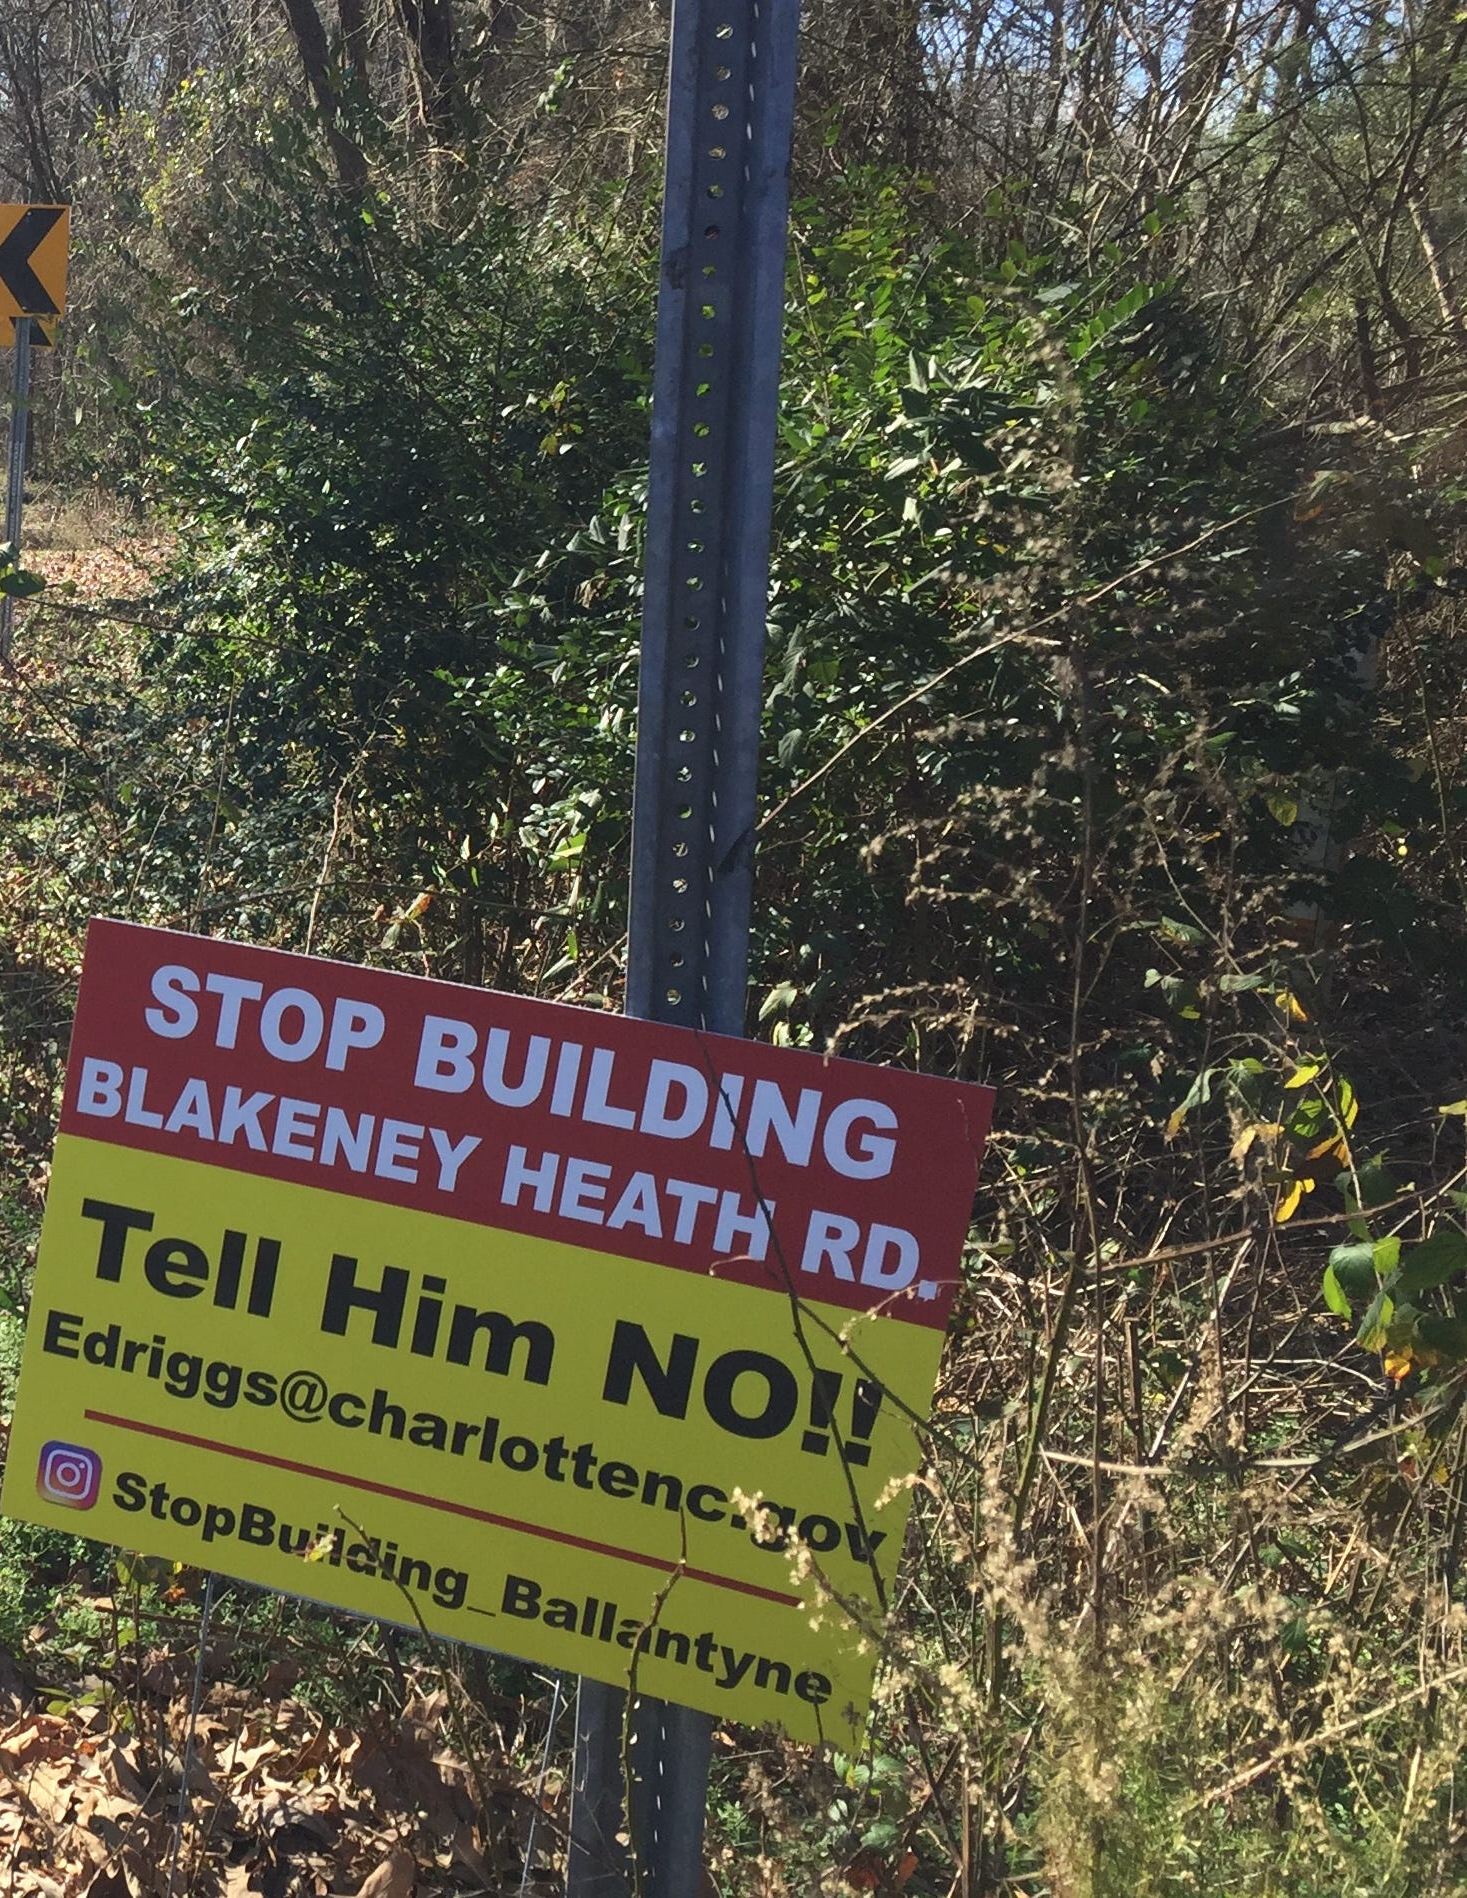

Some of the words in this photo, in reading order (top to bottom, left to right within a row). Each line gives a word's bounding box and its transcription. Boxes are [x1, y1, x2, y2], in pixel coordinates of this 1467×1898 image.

[75, 1056, 482, 1193] BLAKENEY
[500, 1145, 776, 1262] HEATH
[800, 1210, 940, 1301] RD.
[144, 964, 386, 1072] STOP
[413, 1014, 899, 1181] BUILDING
[42, 1309, 888, 1564] Edriggs@charlottenc.gov
[81, 1197, 282, 1318] Tell
[320, 1252, 556, 1386] Him
[601, 1319, 884, 1467] NO!!
